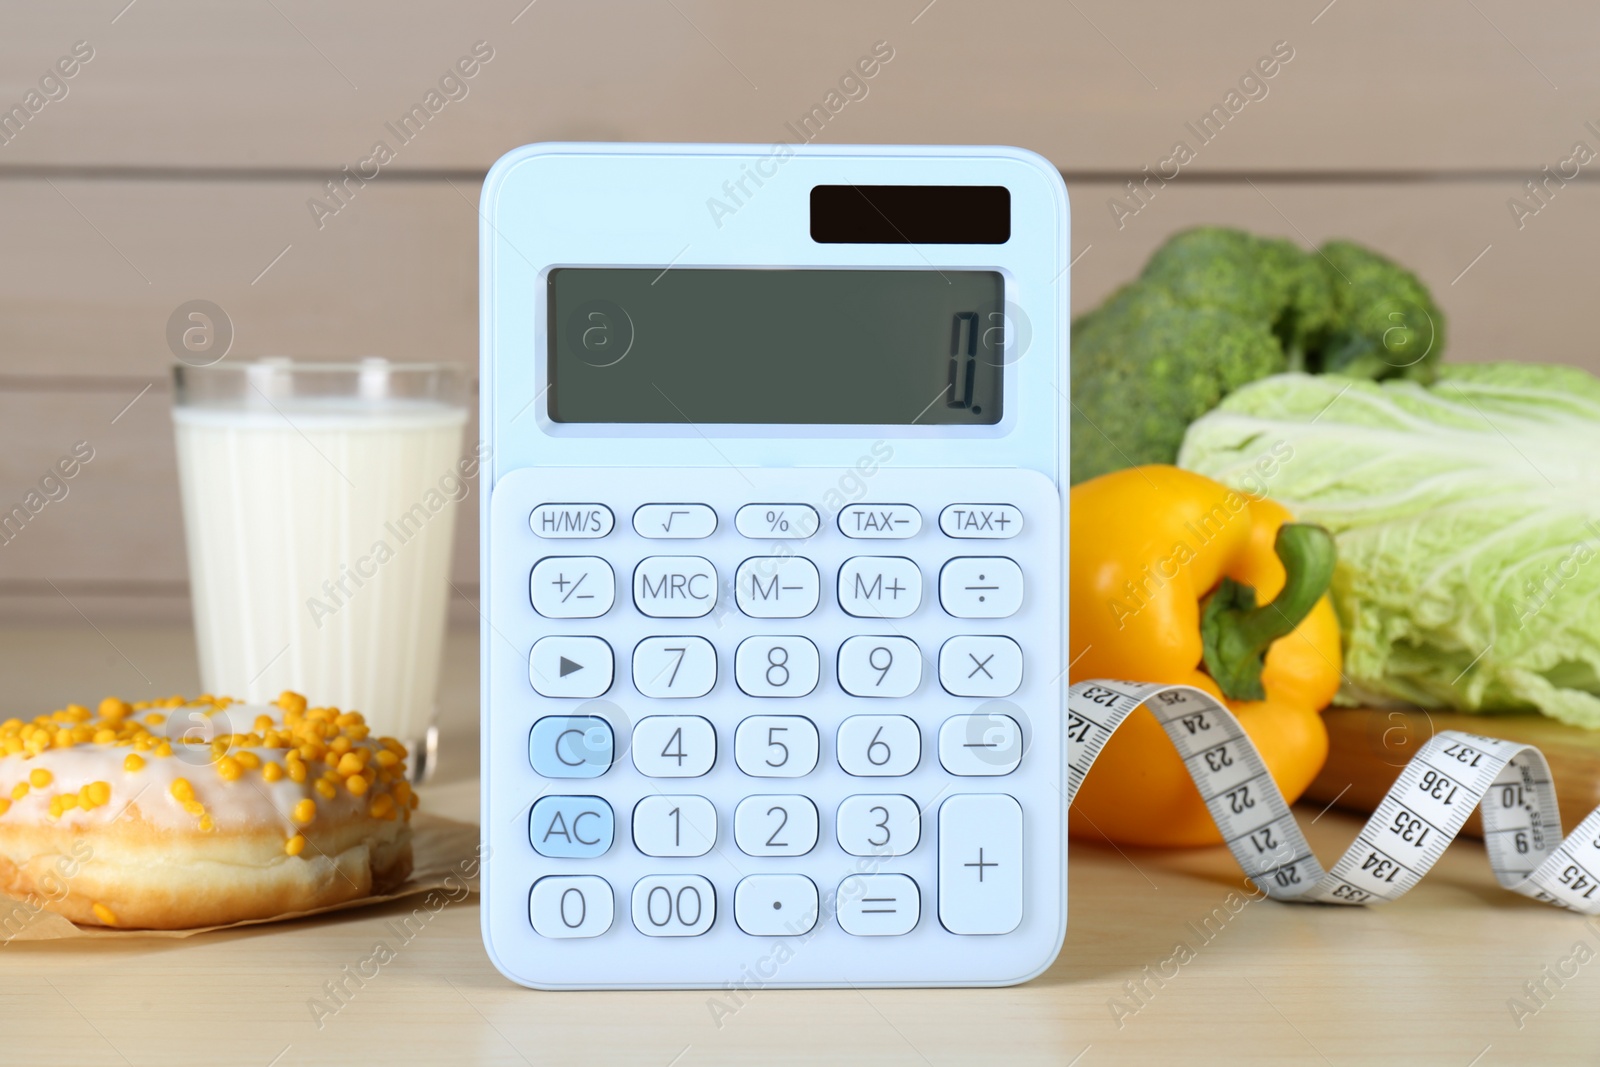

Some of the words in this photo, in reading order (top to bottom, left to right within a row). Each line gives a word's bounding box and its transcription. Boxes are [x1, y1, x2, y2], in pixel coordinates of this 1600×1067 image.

[542, 510, 602, 533] H/M/S
[765, 510, 789, 532] %
[953, 510, 1011, 531] TAX+
[642, 573, 710, 600] MRC
[854, 572, 906, 601] M+
[662, 646, 689, 688] 7
[765, 646, 790, 687] 8
[868, 646, 894, 687] 9
[1083, 687, 1120, 708] 123
[1068, 714, 1092, 743] 12
[1182, 714, 1211, 735] 24
[554, 727, 589, 769] C
[660, 727, 688, 767] 4
[765, 727, 789, 768] 5
[866, 725, 892, 766] 6
[1204, 746, 1233, 772] 23
[1443, 744, 1482, 768] 137
[1226, 786, 1256, 814] 22
[1419, 771, 1458, 805] 136
[1502, 786, 1525, 808] 10
[542, 810, 601, 846] AC
[668, 807, 680, 847] 1
[765, 806, 789, 847] 2
[867, 805, 891, 847] 3
[1251, 828, 1278, 853] 21
[1389, 811, 1430, 847] 135
[963, 847, 999, 883] +
[1274, 866, 1302, 887] 20
[1361, 852, 1400, 883] 134
[1332, 884, 1371, 903] 133
[1558, 865, 1598, 899] 145
[560, 887, 587, 929] 0
[647, 885, 702, 927] 00
[861, 897, 897, 914] =
